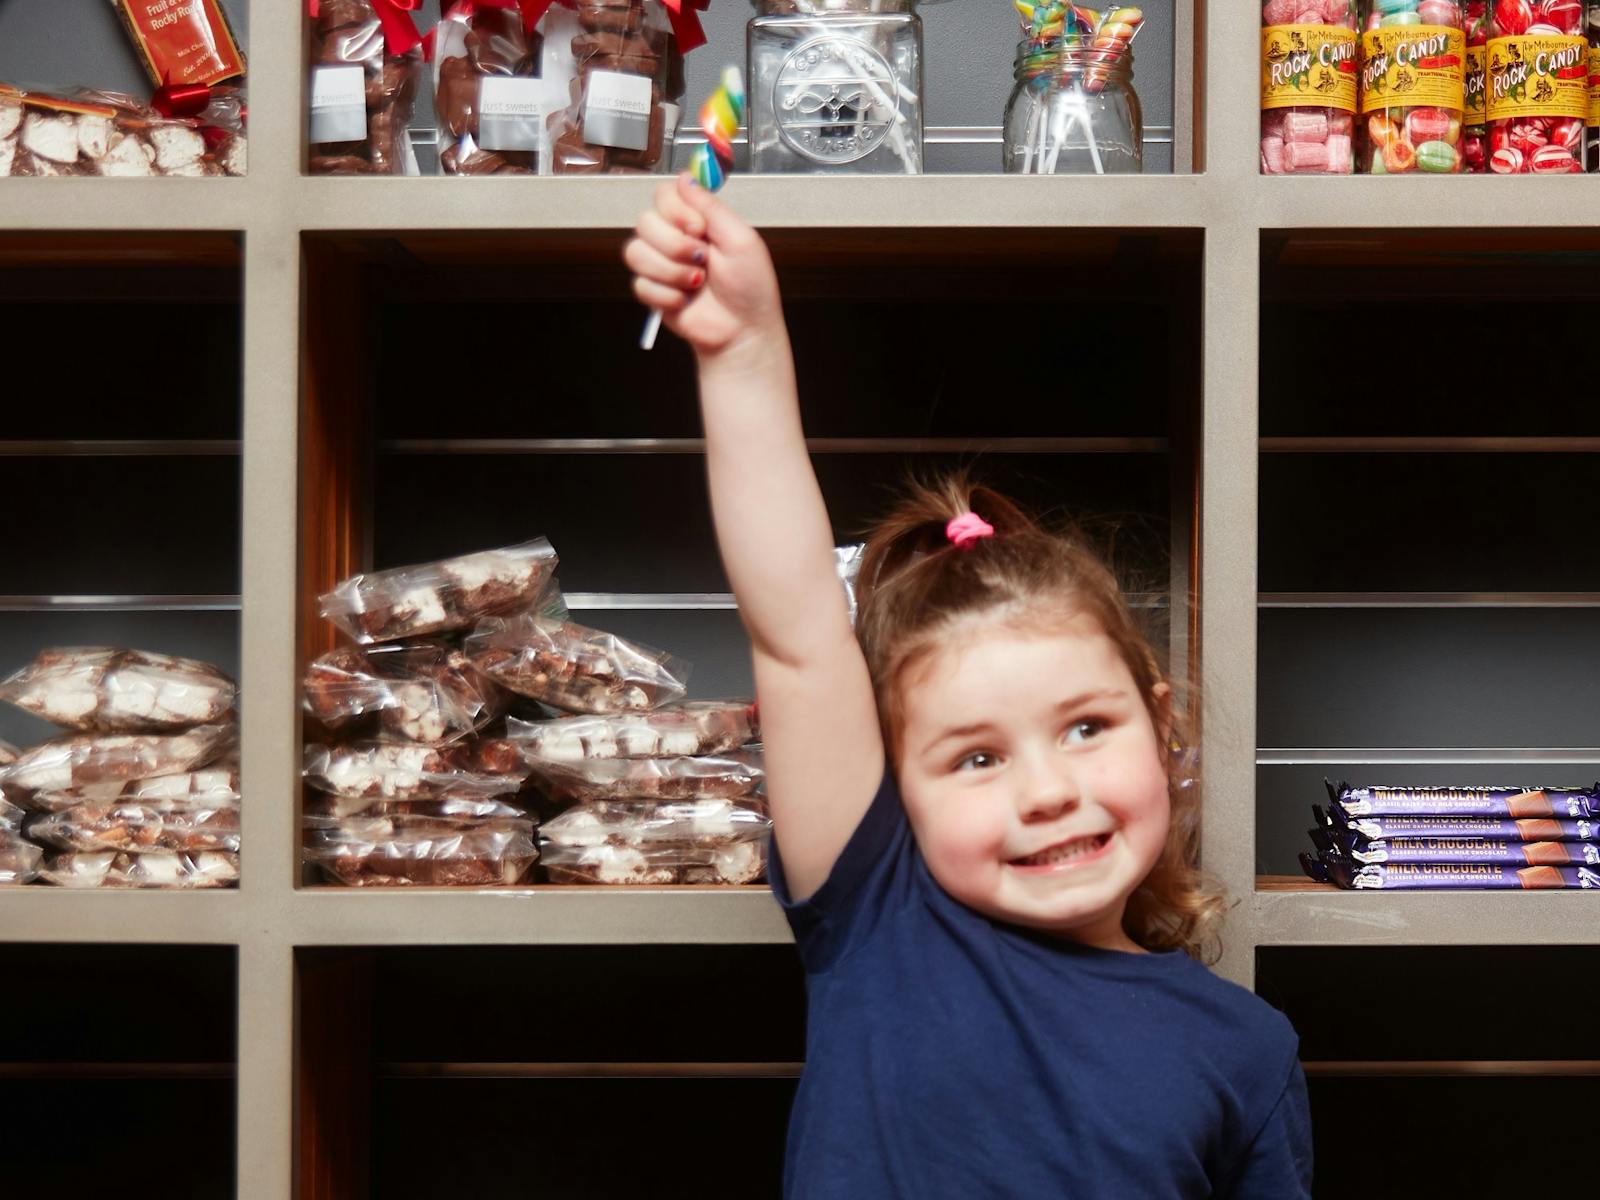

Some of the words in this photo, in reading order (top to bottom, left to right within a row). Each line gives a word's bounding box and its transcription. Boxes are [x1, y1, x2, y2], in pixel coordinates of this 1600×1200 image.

[146, 0, 169, 16] Fruit
[150, 12, 178, 30] Rocky
[177, 4, 200, 18] Roa
[1395, 31, 1430, 40] Melbourne
[1534, 40, 1568, 49] Melbourne
[1271, 53, 1310, 86] ROCK
[1319, 40, 1356, 67] CANDY
[1362, 55, 1388, 91] ROCK
[1396, 34, 1446, 67] CANDY
[1493, 64, 1528, 98] ROCK
[1535, 45, 1581, 76] CANDY
[505, 102, 538, 112] sweets
[1375, 790, 1408, 800] MILK
[1391, 839, 1424, 849] MILK
[1386, 864, 1419, 874] MILK
